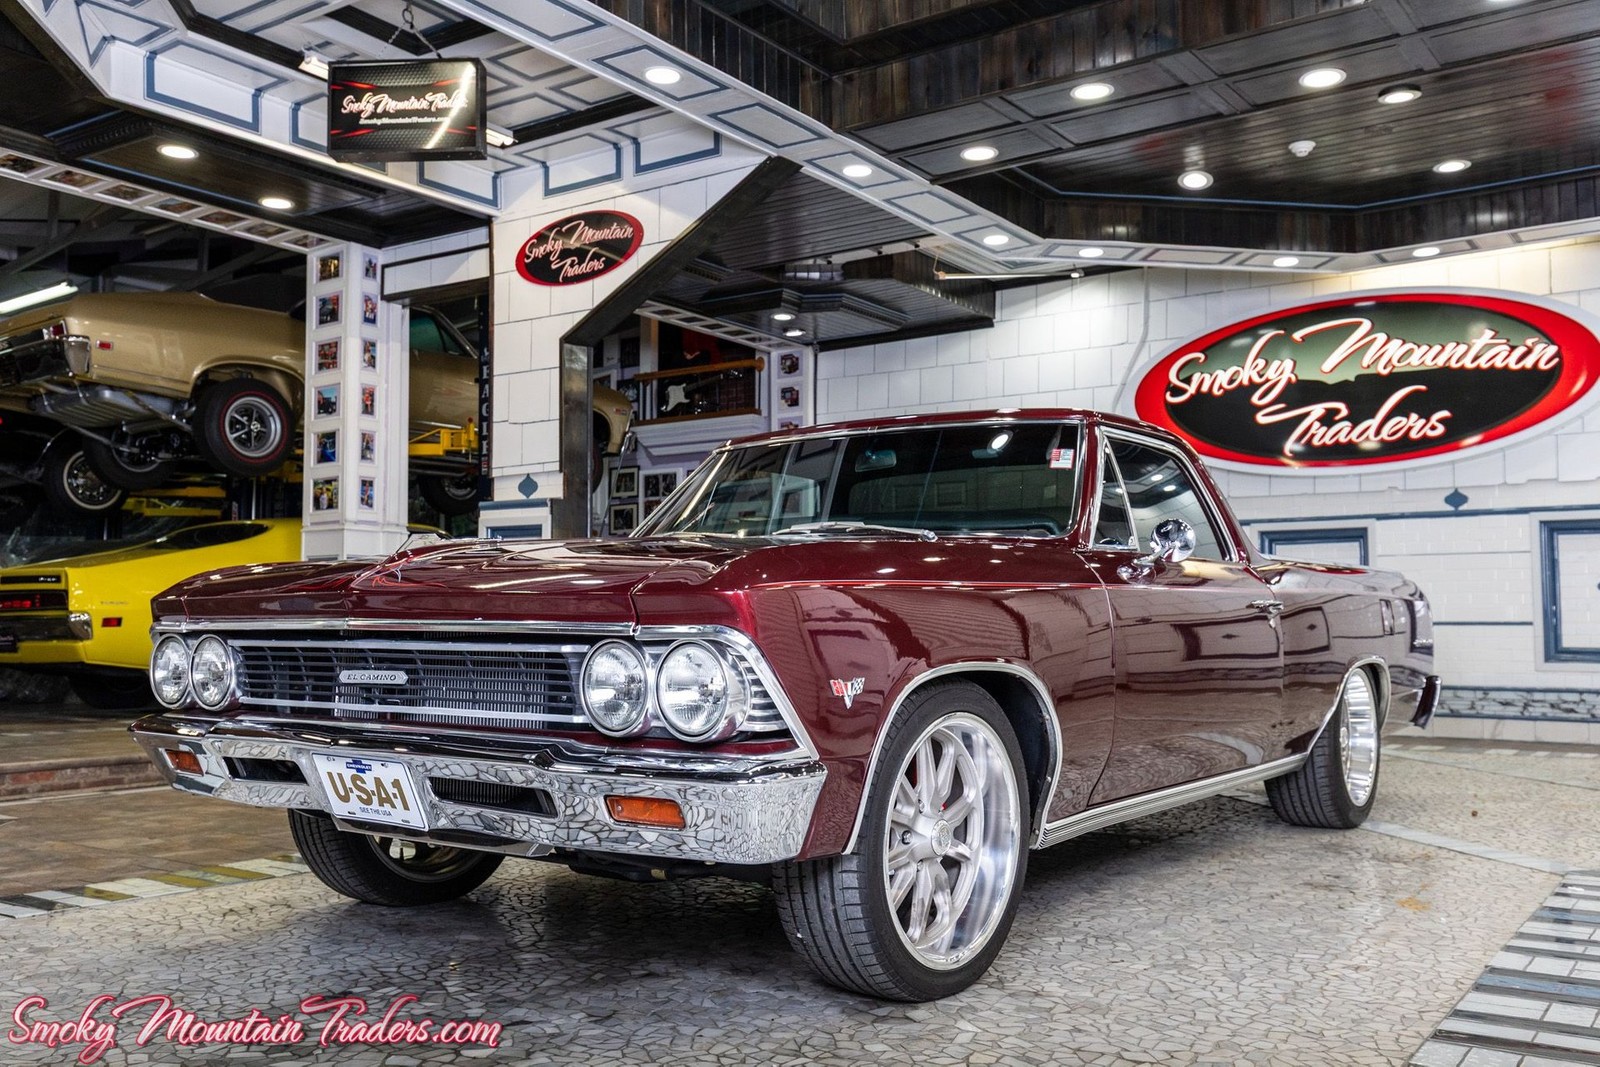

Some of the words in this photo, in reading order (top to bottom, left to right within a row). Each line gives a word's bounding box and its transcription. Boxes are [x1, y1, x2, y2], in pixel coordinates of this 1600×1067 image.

[341, 92, 375, 118] Smoky
[370, 93, 430, 113] Mountain
[524, 227, 563, 263] Smoky
[562, 220, 634, 244] Mountain
[551, 247, 606, 283] Traders
[1164, 329, 1297, 405] Smoky
[1292, 317, 1561, 375] Mountain
[1255, 384, 1453, 457] Traders
[347, 673, 358, 681] EL
